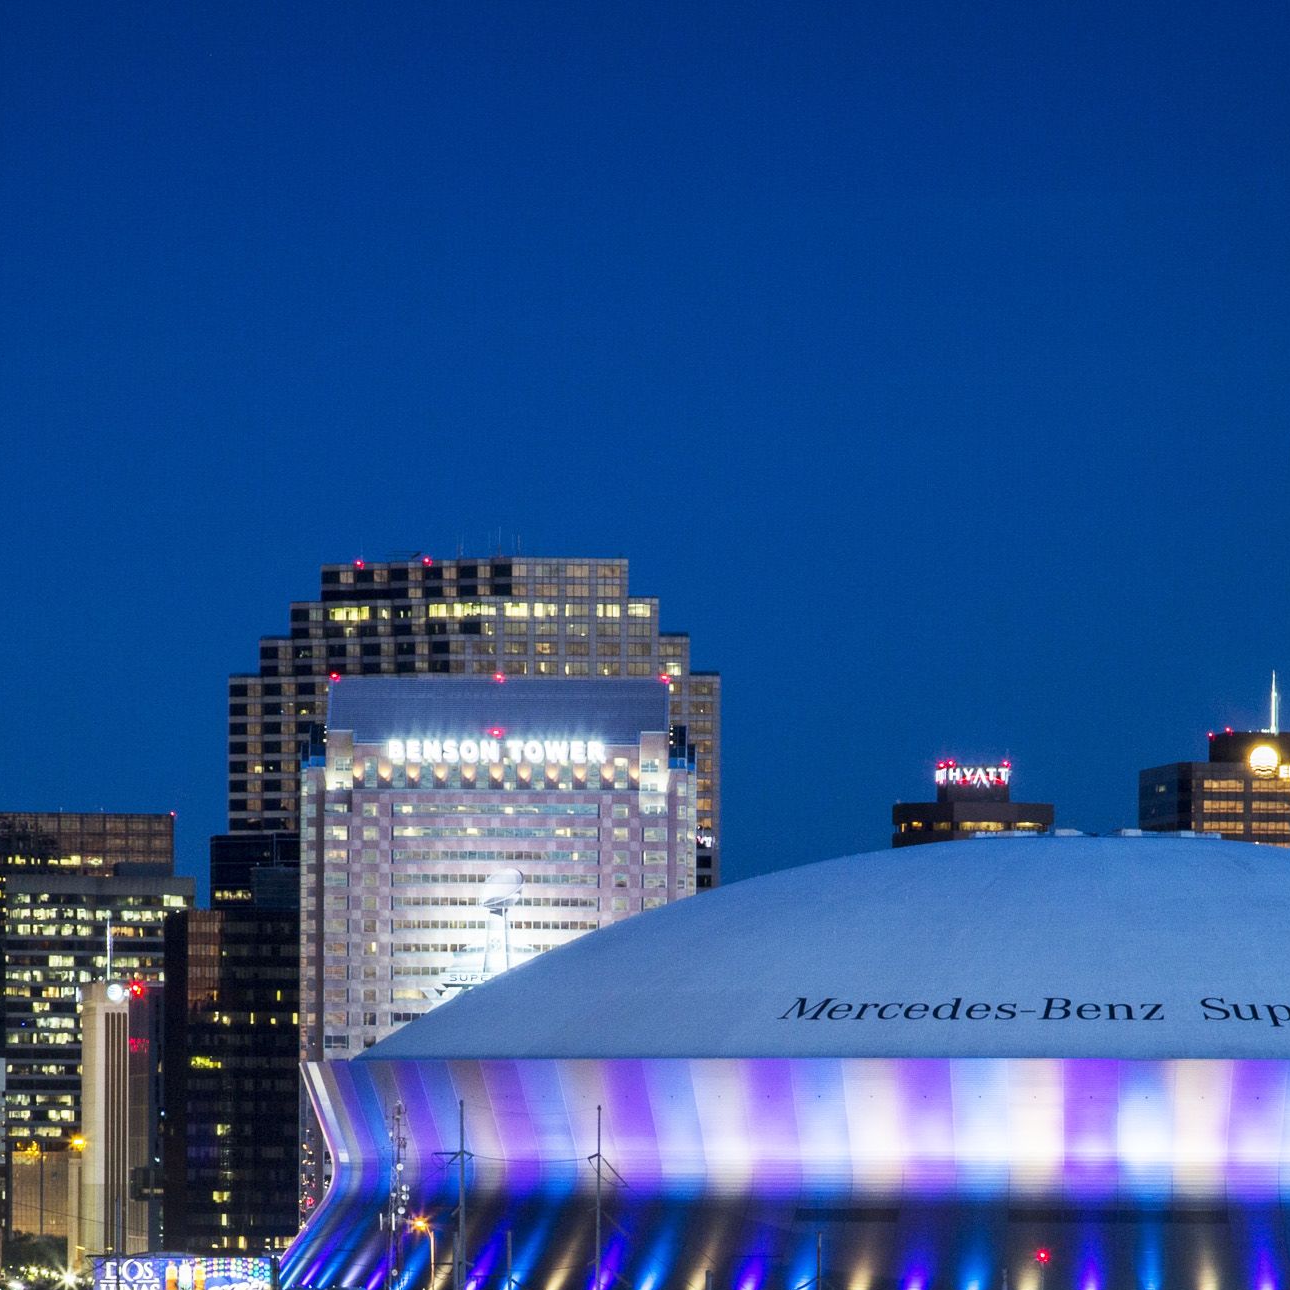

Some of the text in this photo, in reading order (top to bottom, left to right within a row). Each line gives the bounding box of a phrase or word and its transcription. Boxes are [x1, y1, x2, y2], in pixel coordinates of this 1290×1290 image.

[388, 739, 607, 764] BENSON TOWER
[948, 767, 1010, 785] HYATT
[777, 997, 1165, 1022] Mercedes-Benz
